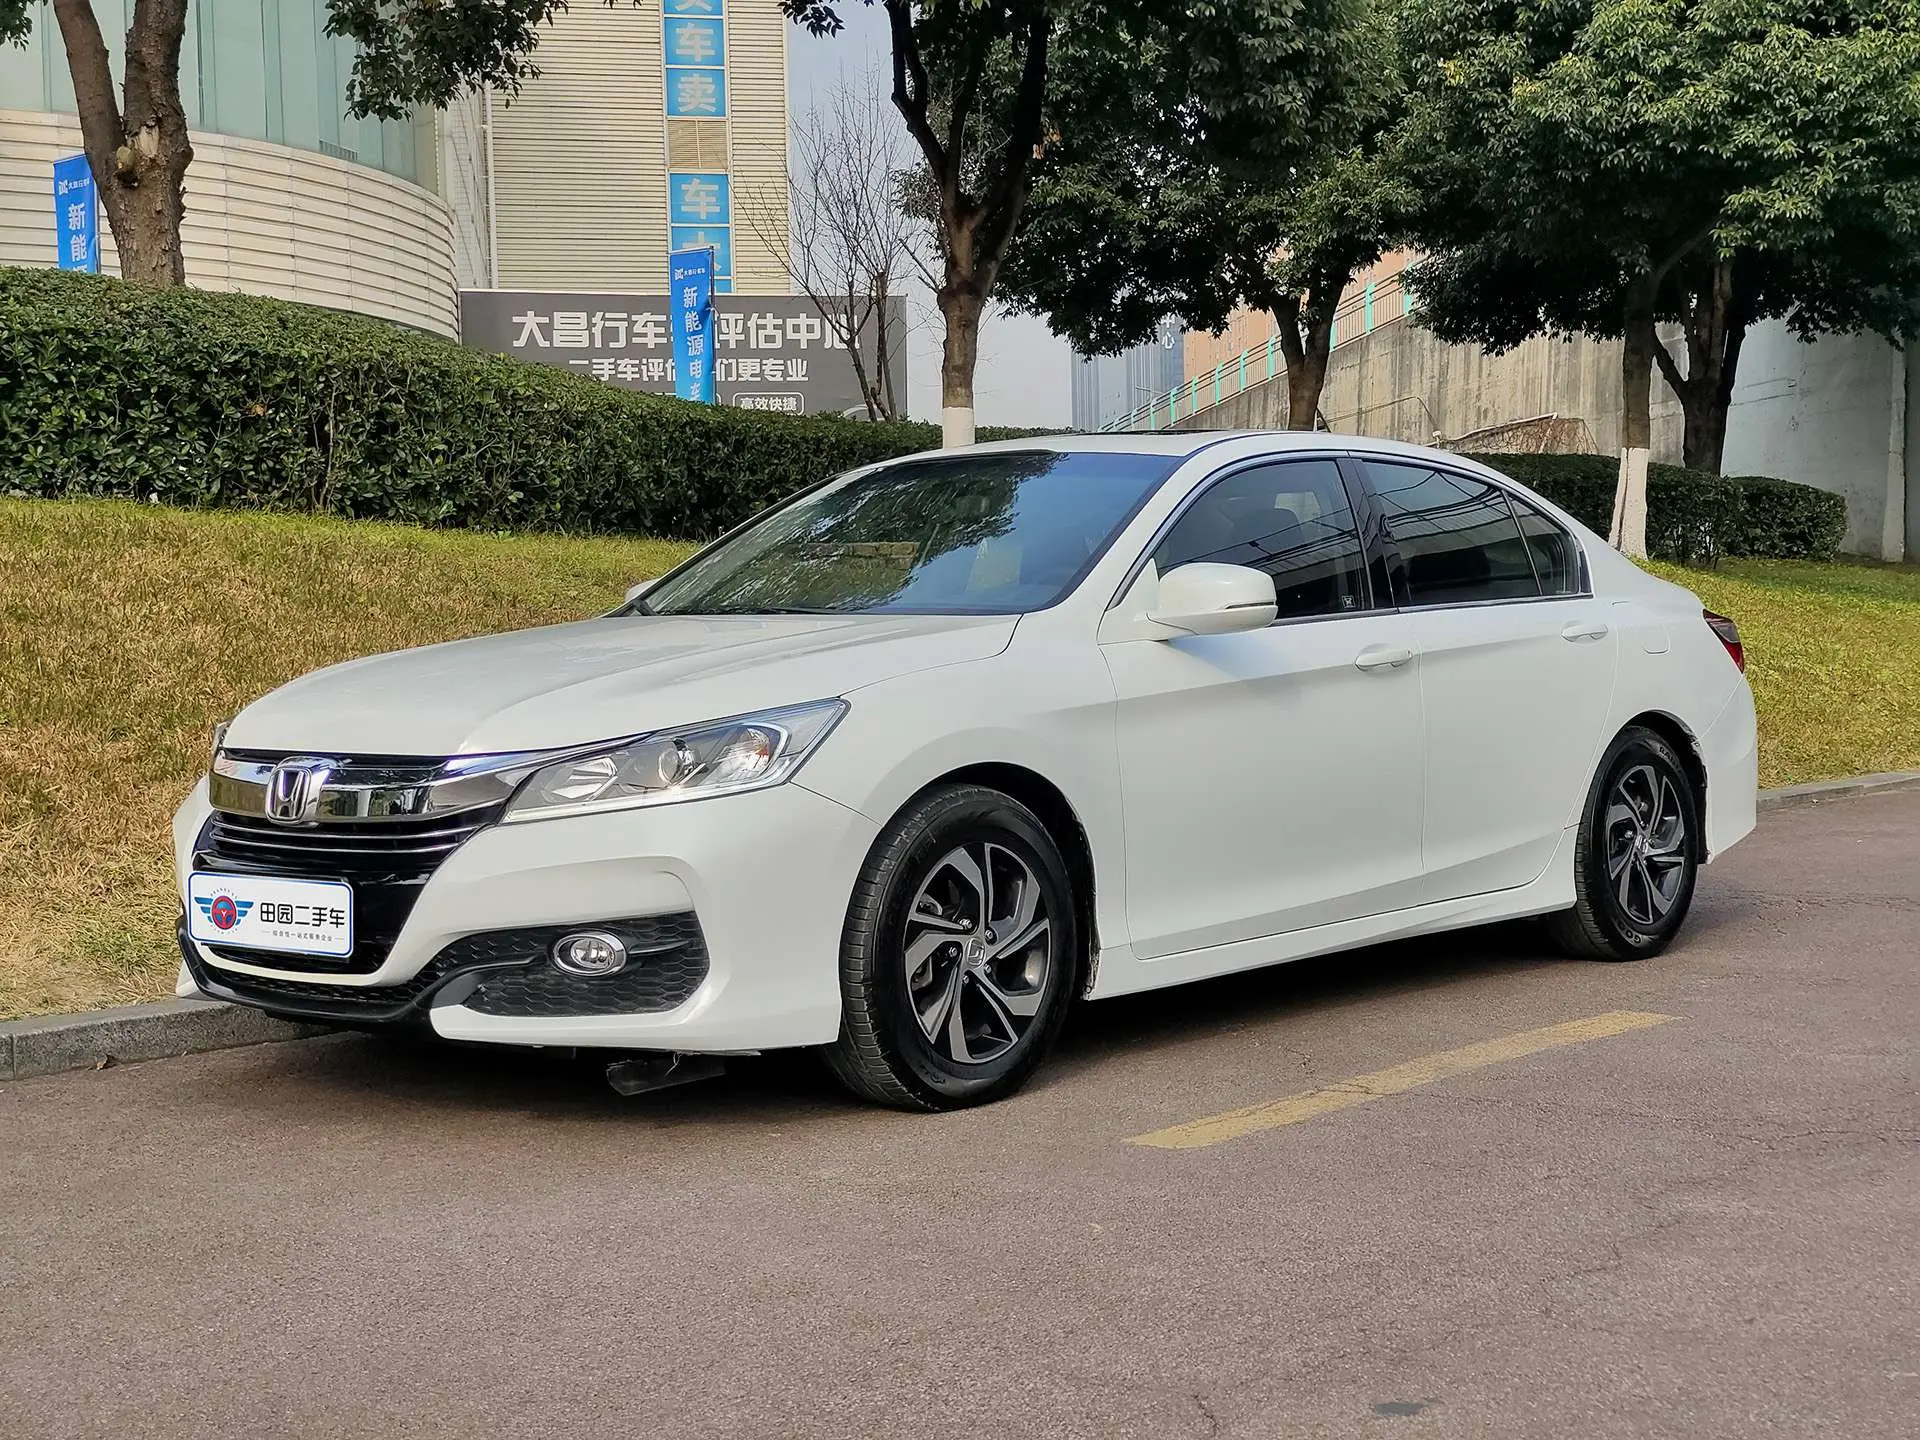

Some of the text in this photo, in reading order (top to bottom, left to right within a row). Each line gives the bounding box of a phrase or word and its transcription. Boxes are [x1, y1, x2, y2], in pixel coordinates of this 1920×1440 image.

[511, 310, 860, 350] 大昌行车评估中心
[568, 357, 810, 382] 手车评们更专业
[260, 902, 345, 928] 田园二手车
